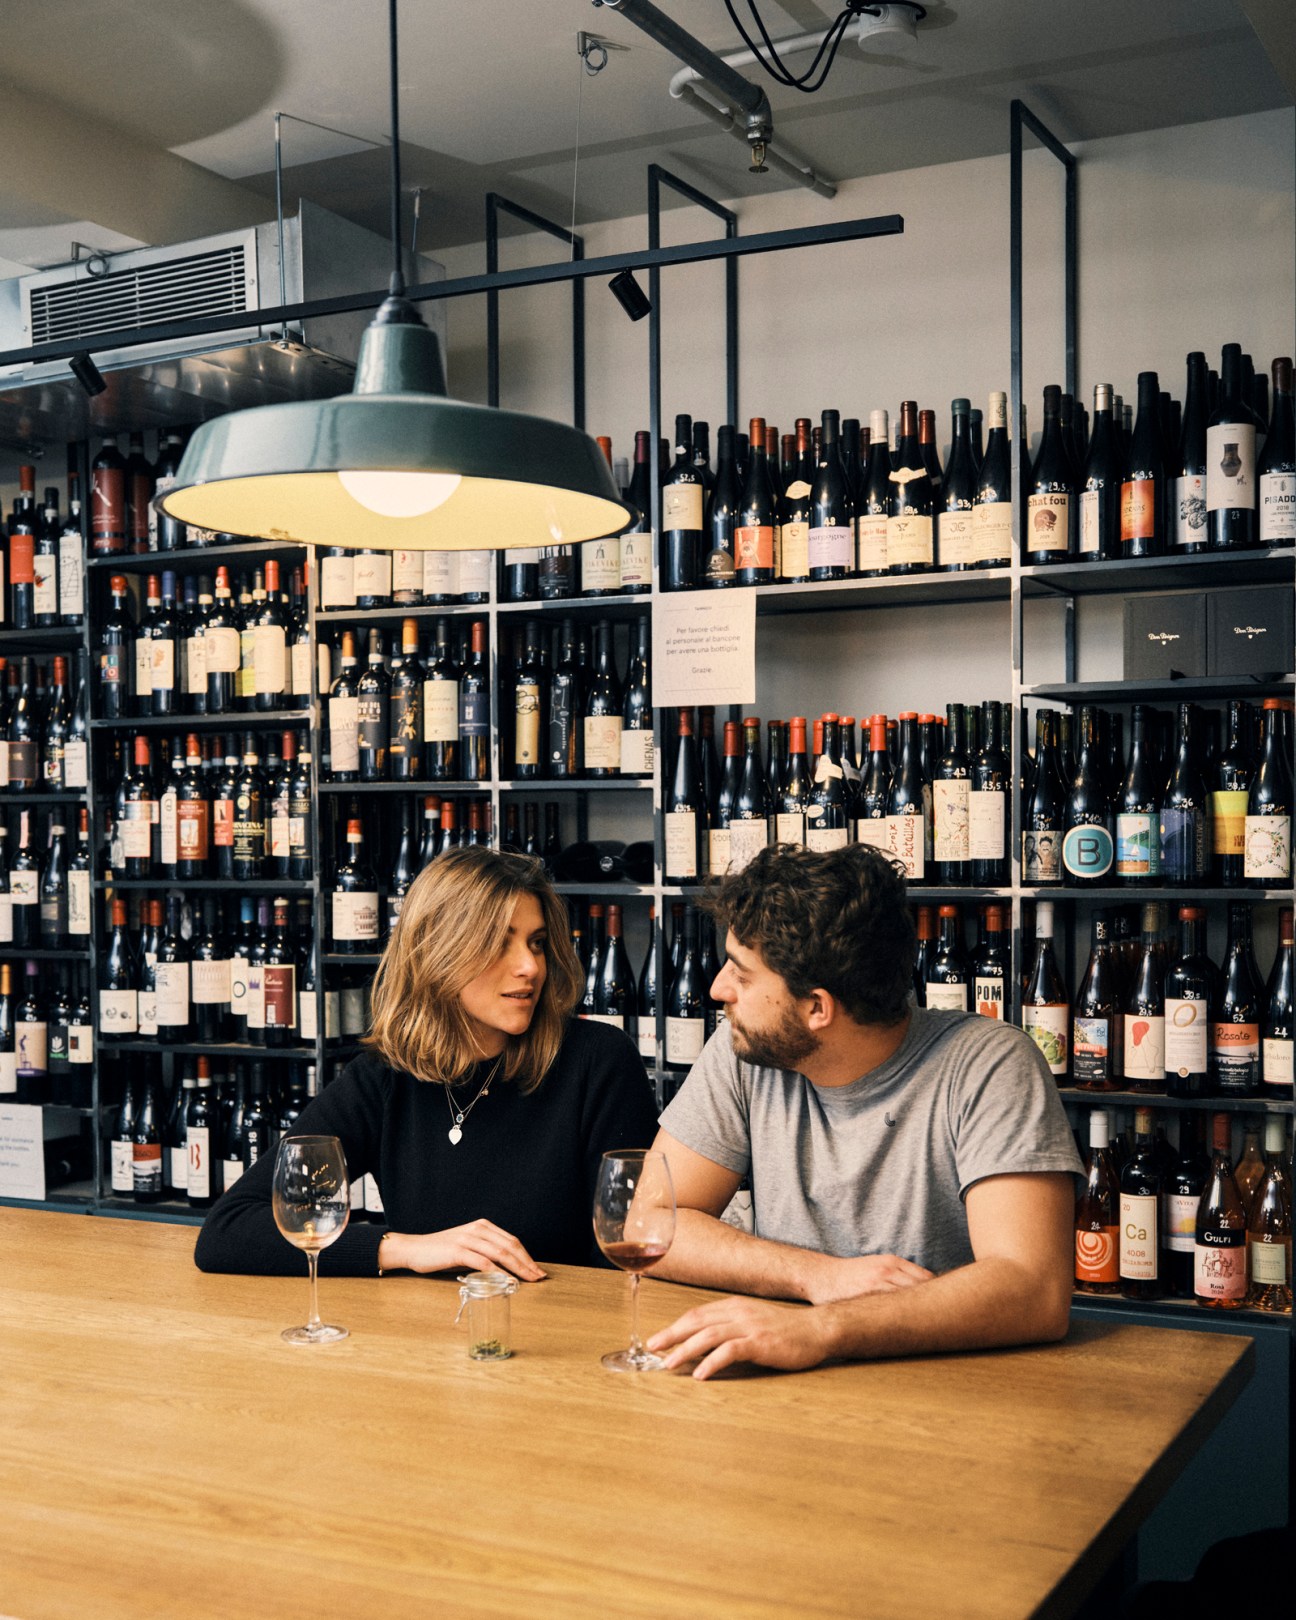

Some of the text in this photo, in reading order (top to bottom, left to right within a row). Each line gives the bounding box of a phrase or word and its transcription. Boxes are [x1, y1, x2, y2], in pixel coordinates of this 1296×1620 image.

[1050, 495, 1066, 506] fou
[673, 637, 704, 645] personale
[710, 645, 738, 653] bottiglia
[1078, 838, 1100, 866] B
[977, 985, 1002, 1001] POM
[1233, 1013, 1246, 1023] 52
[1125, 1224, 1147, 1241] Ca
